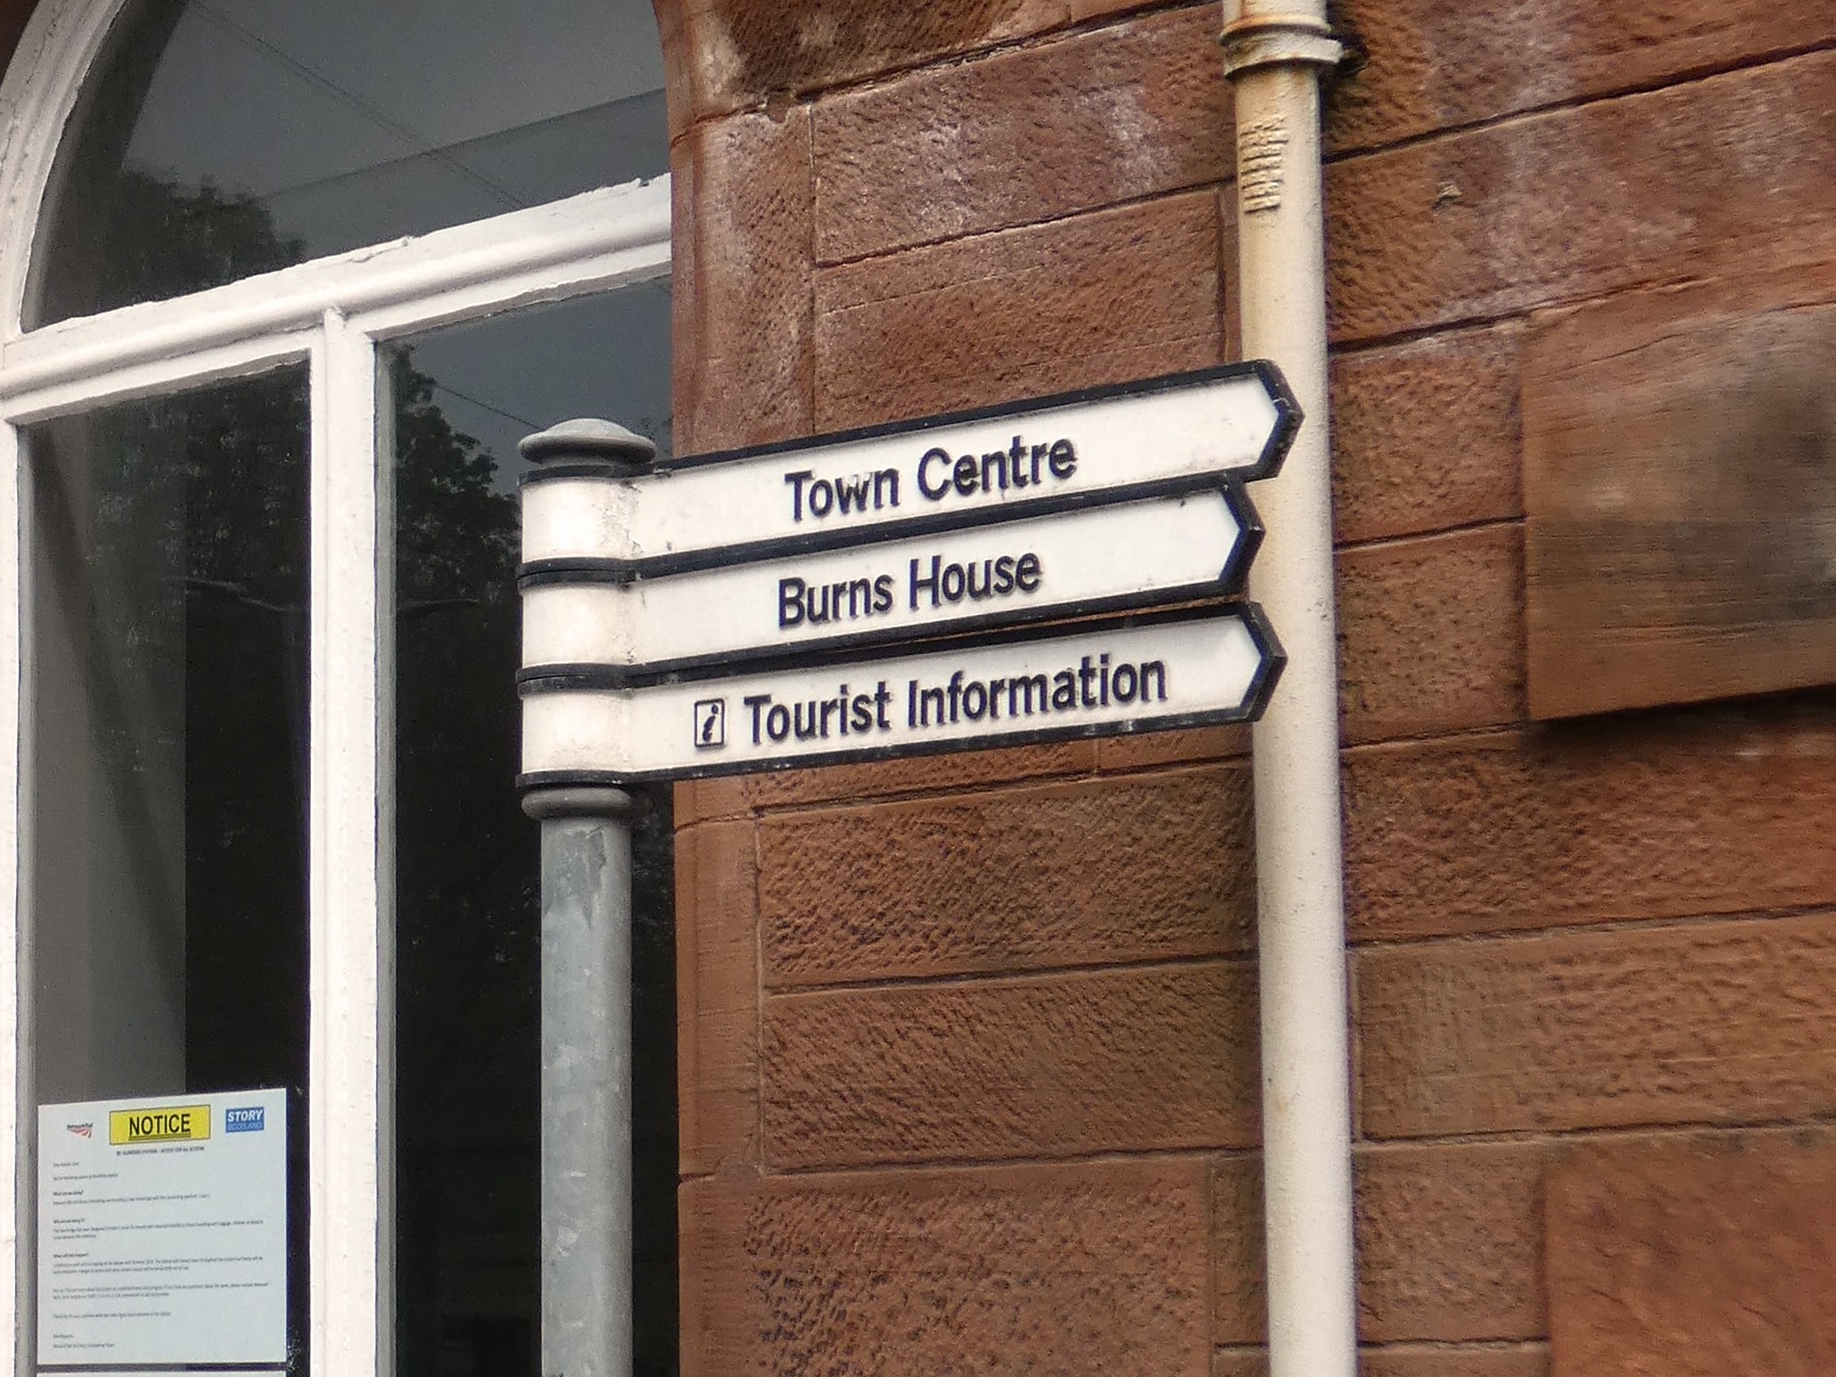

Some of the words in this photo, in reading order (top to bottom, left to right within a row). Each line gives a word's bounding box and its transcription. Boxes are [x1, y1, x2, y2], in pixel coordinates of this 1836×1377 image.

[784, 462, 900, 522] Town
[915, 434, 1079, 501] Centre
[777, 574, 894, 628] Burns
[909, 551, 1043, 612] House
[743, 680, 892, 744] Tourist
[908, 654, 1167, 726] Information
[128, 1113, 191, 1137] NOTICE
[227, 1109, 263, 1123] STORY
